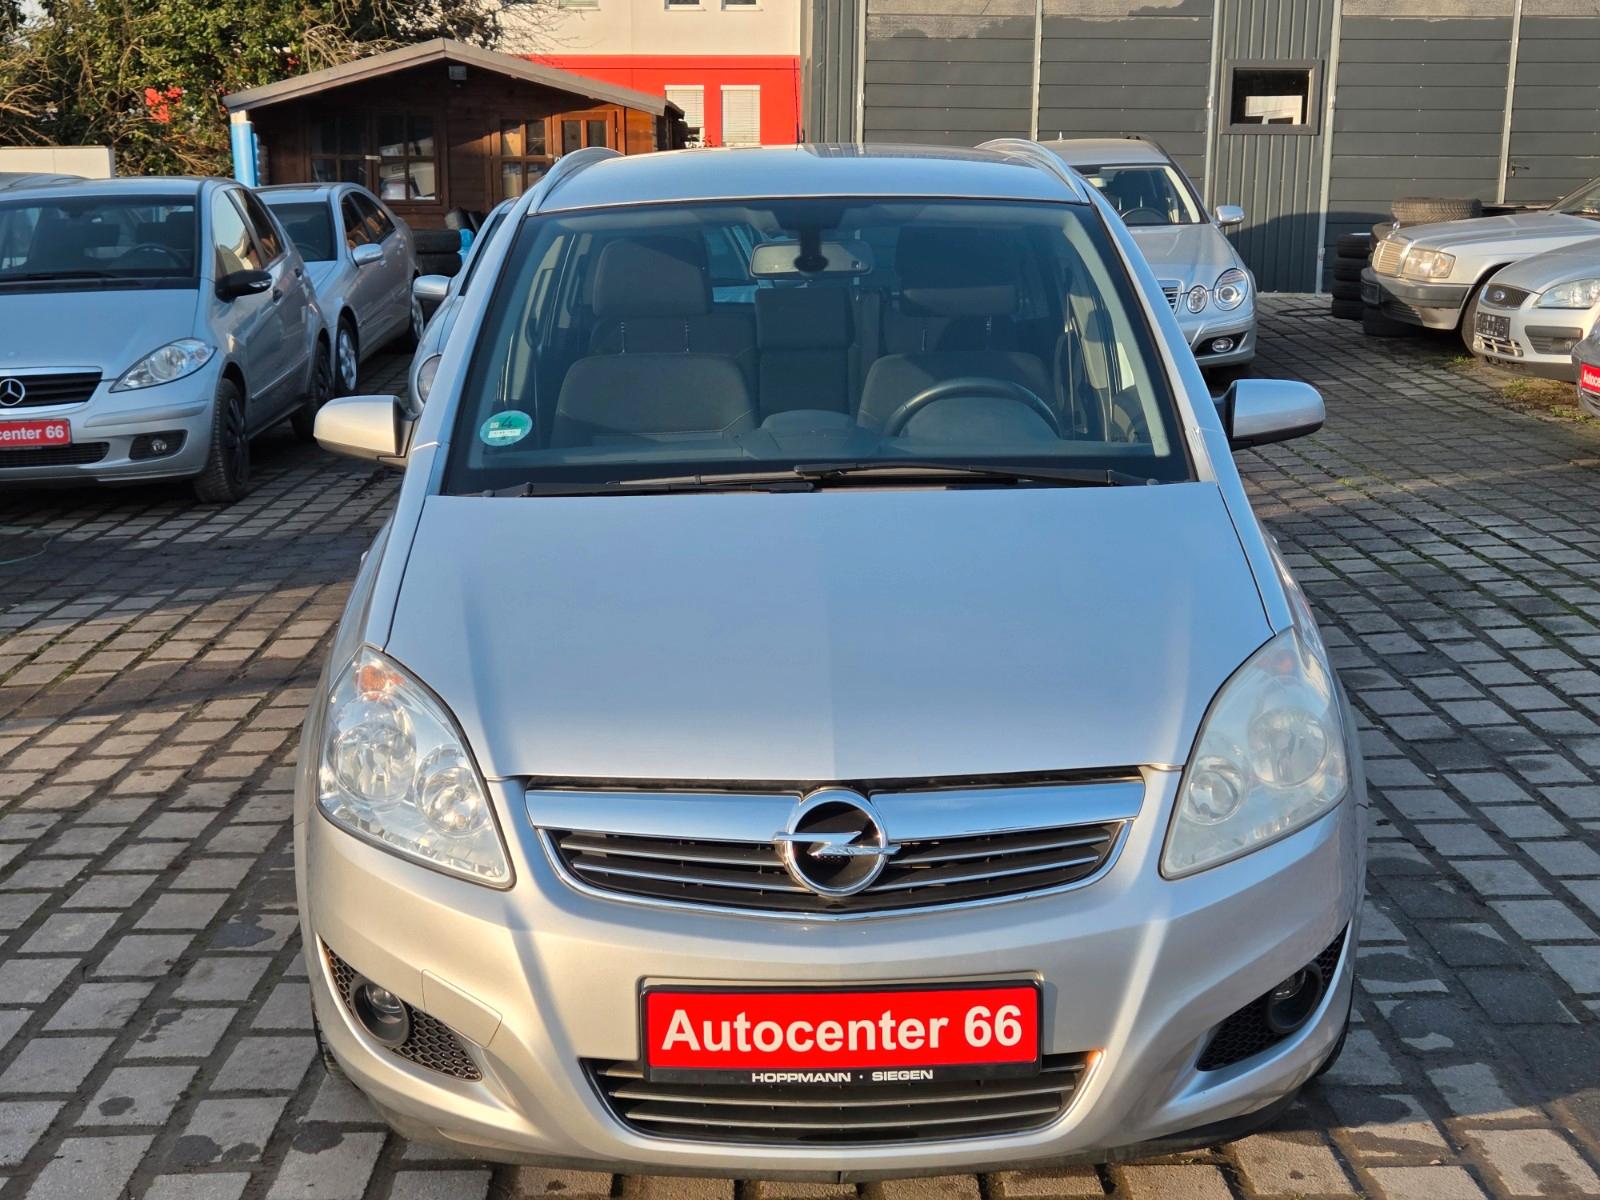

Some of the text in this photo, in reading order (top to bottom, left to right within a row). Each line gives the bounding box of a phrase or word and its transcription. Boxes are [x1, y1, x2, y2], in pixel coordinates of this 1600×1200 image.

[501, 415, 512, 427] 4
[46, 425, 65, 439] 66
[661, 1004, 1022, 1053] Autocenter 66
[752, 1070, 933, 1083] HOPPMANN SIEGEN
